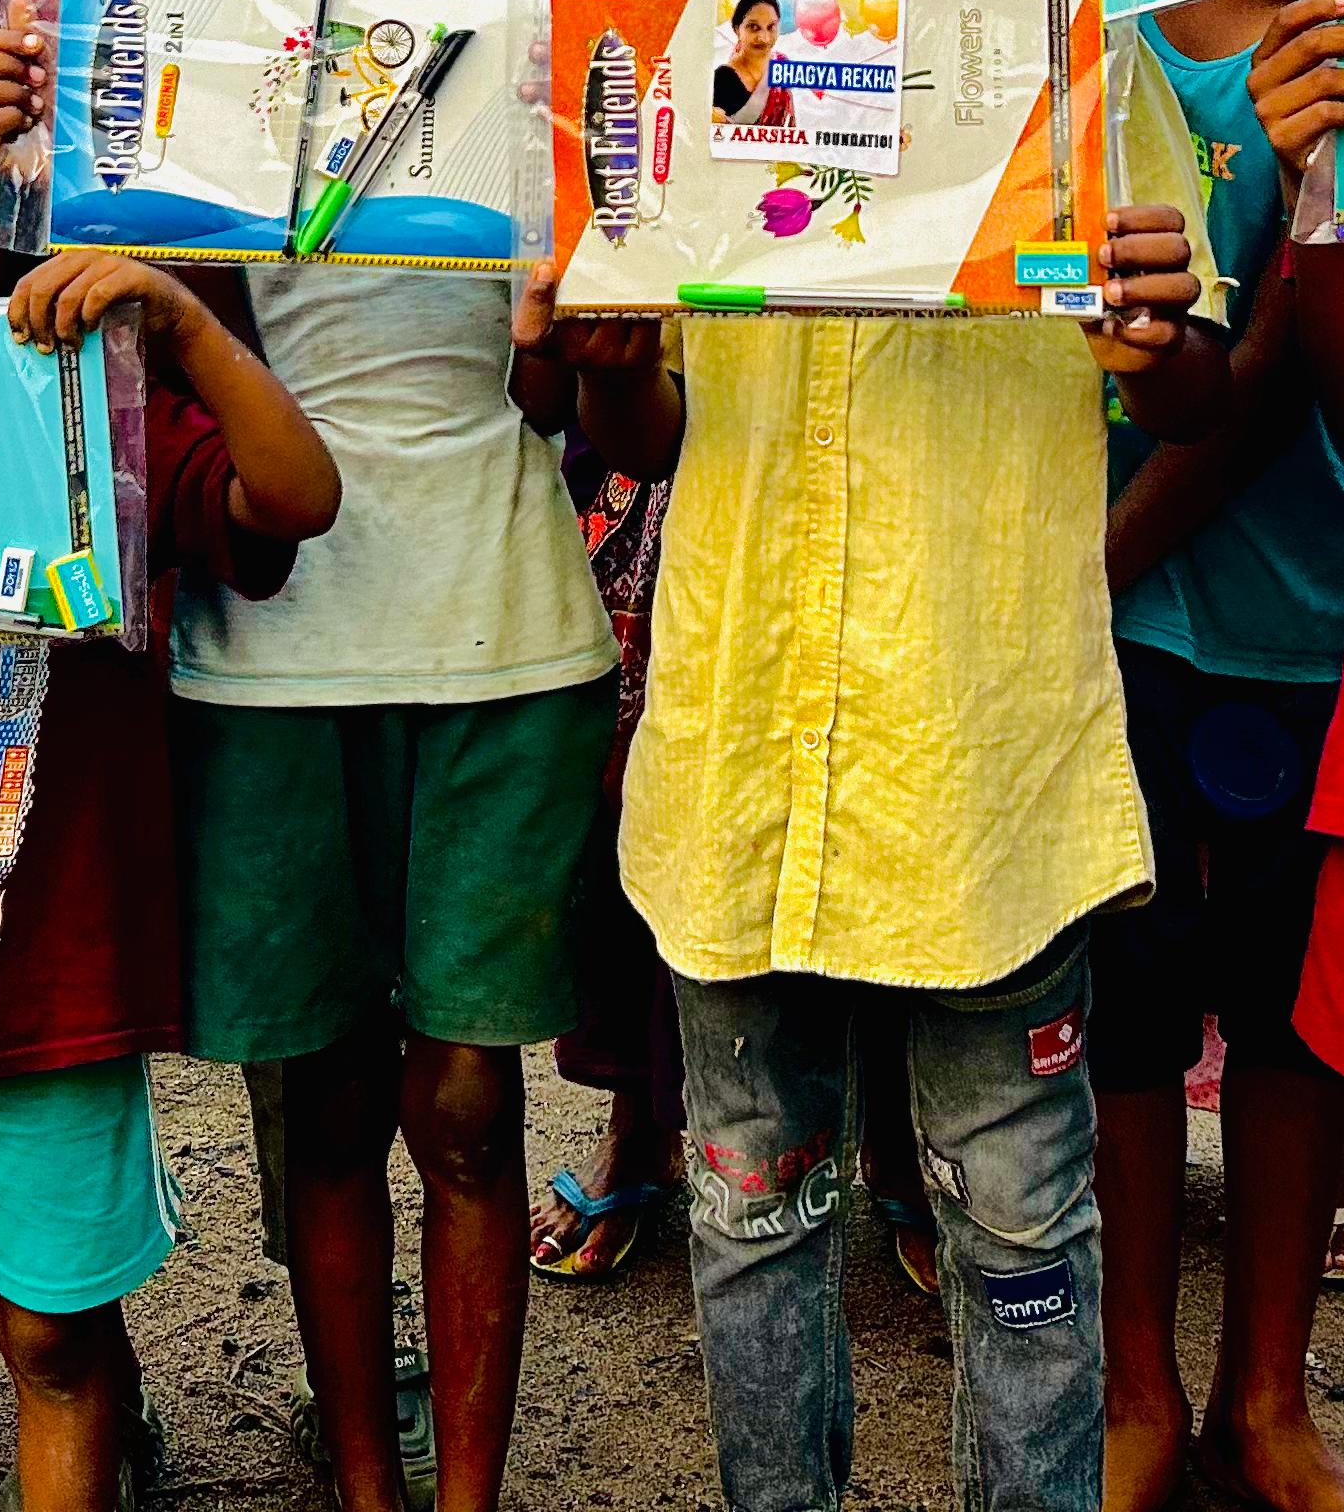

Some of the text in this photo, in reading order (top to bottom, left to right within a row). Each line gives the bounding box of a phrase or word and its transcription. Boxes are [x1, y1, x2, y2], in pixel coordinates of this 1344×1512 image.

[94, 2, 149, 176] Best Friends
[157, 73, 175, 127] ORIGINAL
[772, 63, 895, 89] BHAGYA REKHA
[953, 8, 984, 126] Flowers
[409, 96, 436, 179] Summe
[590, 45, 639, 228] Best Friends
[654, 113, 670, 174] ORIGINAL
[730, 126, 809, 145] AARSHA
